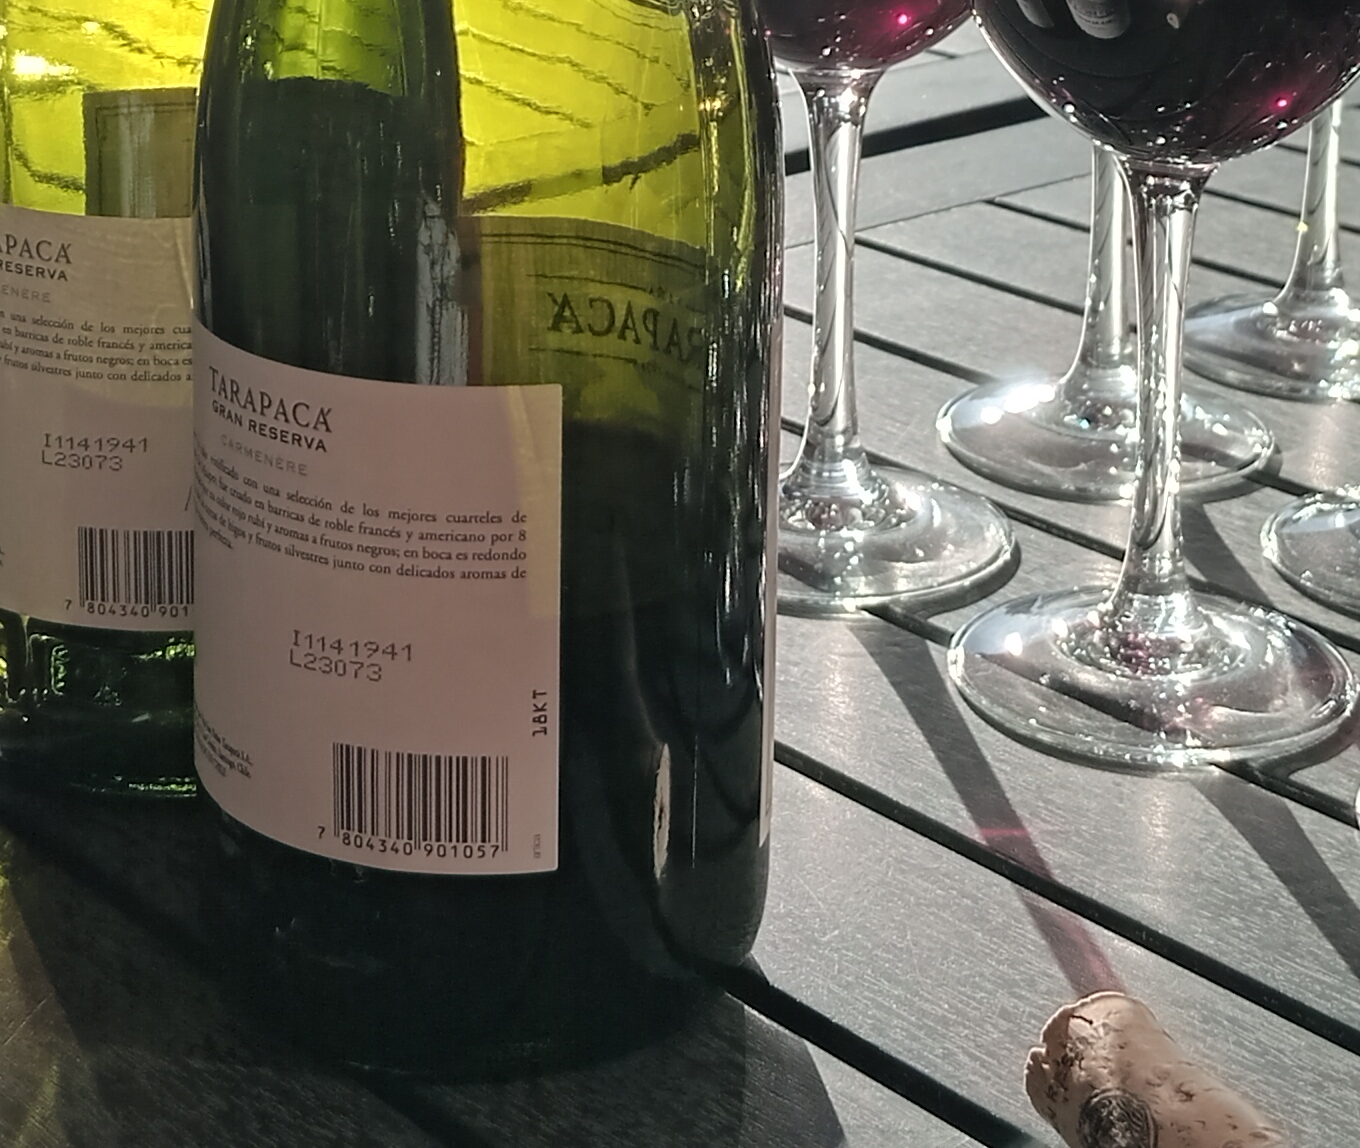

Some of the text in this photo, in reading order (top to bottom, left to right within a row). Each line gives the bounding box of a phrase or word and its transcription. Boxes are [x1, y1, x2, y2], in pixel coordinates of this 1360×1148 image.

[10, 313, 27, 323] una
[31, 314, 74, 330] selección
[80, 320, 94, 332] de
[100, 321, 116, 333] los
[122, 323, 165, 337] mejores
[14, 326, 49, 342] barricas
[52, 333, 64, 345] de
[67, 336, 93, 348] roble
[97, 337, 135, 350] francés
[138, 342, 145, 353] y
[4, 354, 29, 370] frutos
[31, 361, 72, 377] silvestres
[75, 367, 103, 380] junto
[106, 371, 126, 381] con
[130, 370, 181, 382] delicados
[14, 345, 20, 355] y
[21, 346, 53, 359] aromas
[55, 351, 61, 360] a
[63, 349, 93, 363] frutos
[96, 354, 134, 368] negros;
[136, 357, 150, 366] en
[153, 355, 179, 366] boca
[182, 357, 193, 366] es
[209, 365, 333, 433] TARAPACÁ
[212, 400, 328, 453] GRAN RESERVA
[41, 449, 124, 472] L23073
[242, 476, 258, 489] con
[263, 484, 281, 498] una
[286, 489, 333, 511] selección
[340, 500, 355, 514] de
[362, 502, 380, 518] los
[388, 508, 437, 525] mejores
[445, 510, 503, 524] cuarteles
[511, 509, 528, 524] de
[254, 499, 265, 510] en
[267, 499, 305, 522] barricas
[308, 512, 321, 527] de
[324, 517, 355, 533] roble
[358, 520, 401, 539] francés
[405, 530, 414, 543] y
[417, 529, 486, 543] americano
[490, 532, 514, 546] por
[518, 529, 527, 542] 8
[247, 533, 254, 544] y
[255, 532, 282, 552] frutos
[284, 544, 329, 565] silvestres
[332, 554, 365, 571] junto
[368, 563, 391, 574] con
[396, 562, 455, 580] delicados
[459, 569, 507, 580] aromas
[510, 565, 528, 579] de
[266, 521, 273, 533] y
[274, 524, 309, 542] aromas
[312, 535, 317, 544] a
[320, 532, 354, 551] frutos
[356, 543, 400, 559] negros;
[403, 548, 419, 558] en
[422, 545, 452, 560] boca
[455, 551, 469, 561] es
[472, 547, 527, 561] redondo
[63, 598, 73, 611] 7
[86, 601, 150, 618] 804340
[289, 647, 383, 683] L23073
[317, 824, 500, 859] 7 804340 901057
